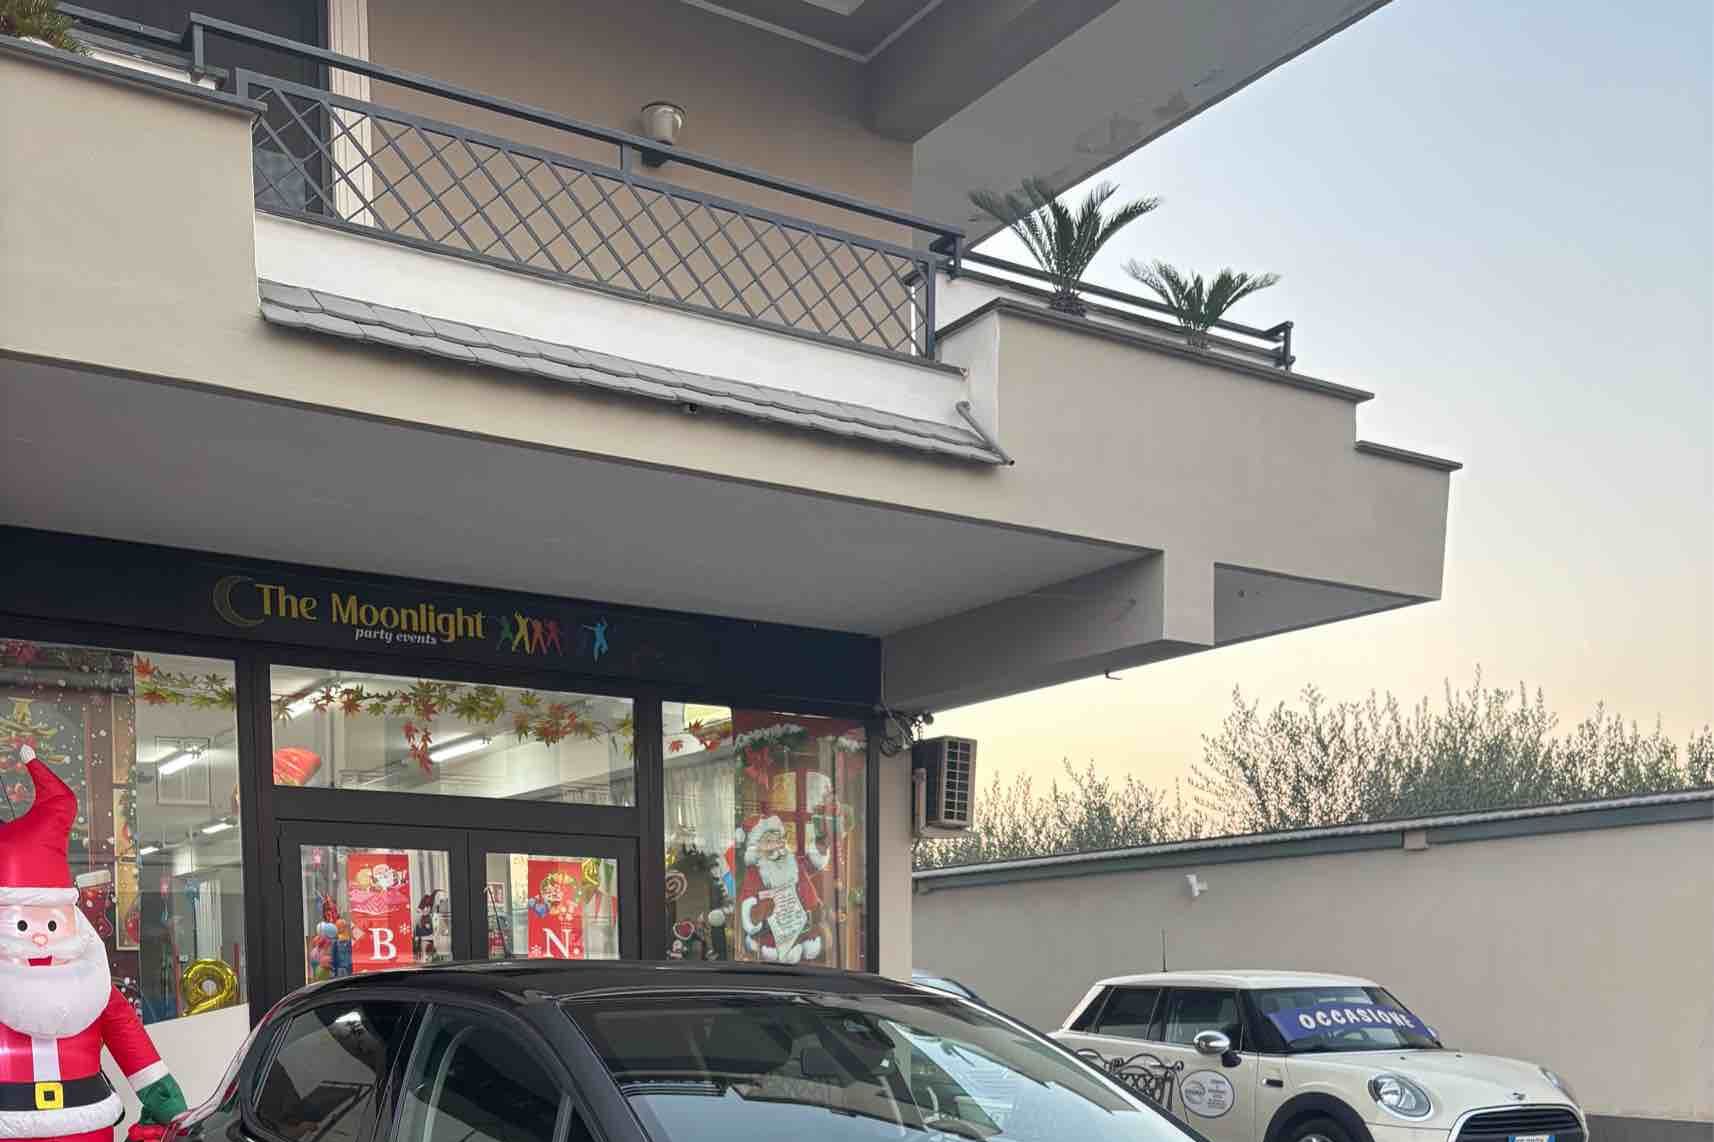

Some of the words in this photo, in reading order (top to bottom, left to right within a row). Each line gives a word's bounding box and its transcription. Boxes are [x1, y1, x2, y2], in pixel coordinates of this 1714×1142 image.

[255, 583, 318, 620] The
[330, 591, 487, 642] Moonlight
[355, 627, 393, 643] party
[396, 632, 438, 645] events
[369, 927, 397, 960] B
[543, 928, 572, 959] N
[1298, 1008, 1415, 1030] OCCASIONE
